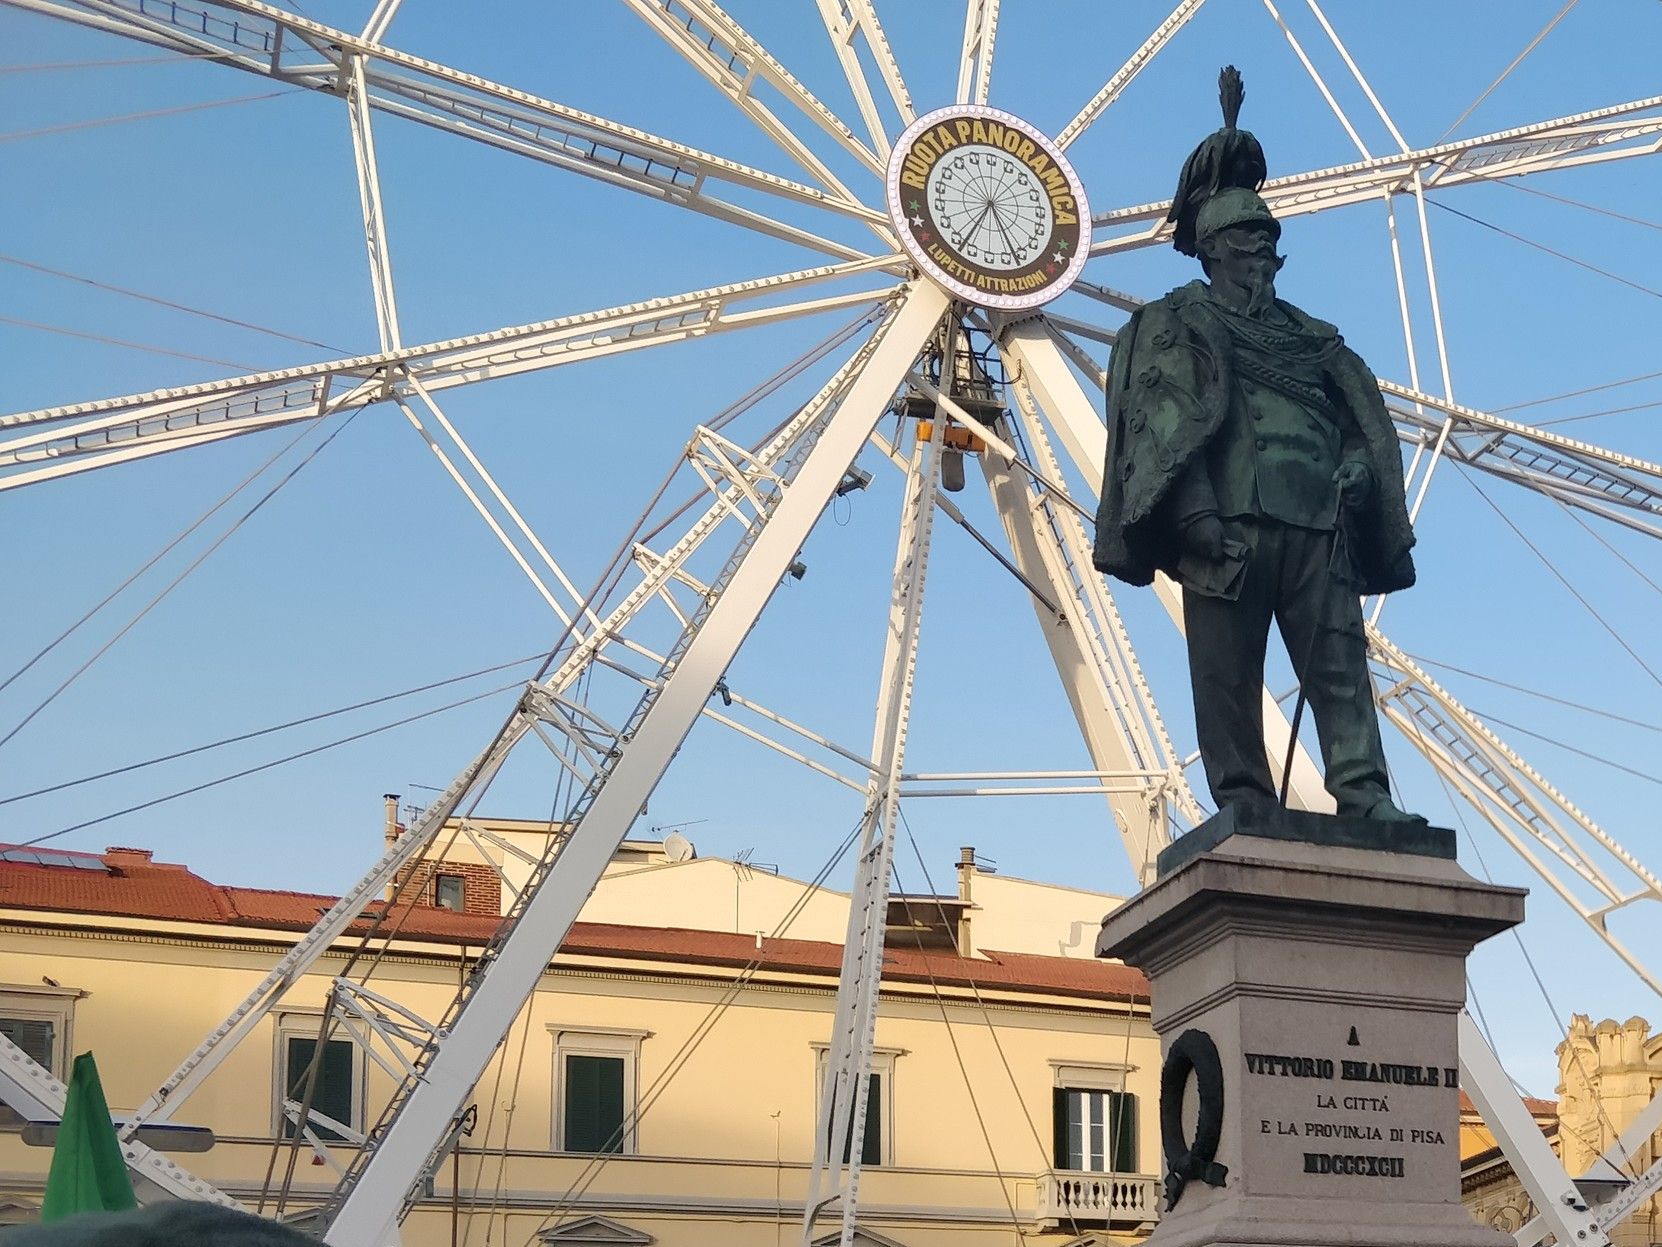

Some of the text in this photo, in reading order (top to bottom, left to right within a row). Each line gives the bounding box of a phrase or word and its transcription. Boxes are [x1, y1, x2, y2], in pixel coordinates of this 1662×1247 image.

[902, 120, 1077, 225] RUOTA PANORAMICA
[927, 242, 1048, 292] LUPETTI ATTRAZIONI
[1347, 1025, 1361, 1046] A
[1244, 1053, 1458, 1088] VITTORIO EMANUELE II
[1316, 1094, 1337, 1109] LA
[1260, 1119, 1445, 1145] E LA PROVINCIA DI PISA
[1303, 1153, 1405, 1178] MDCCCXCII
